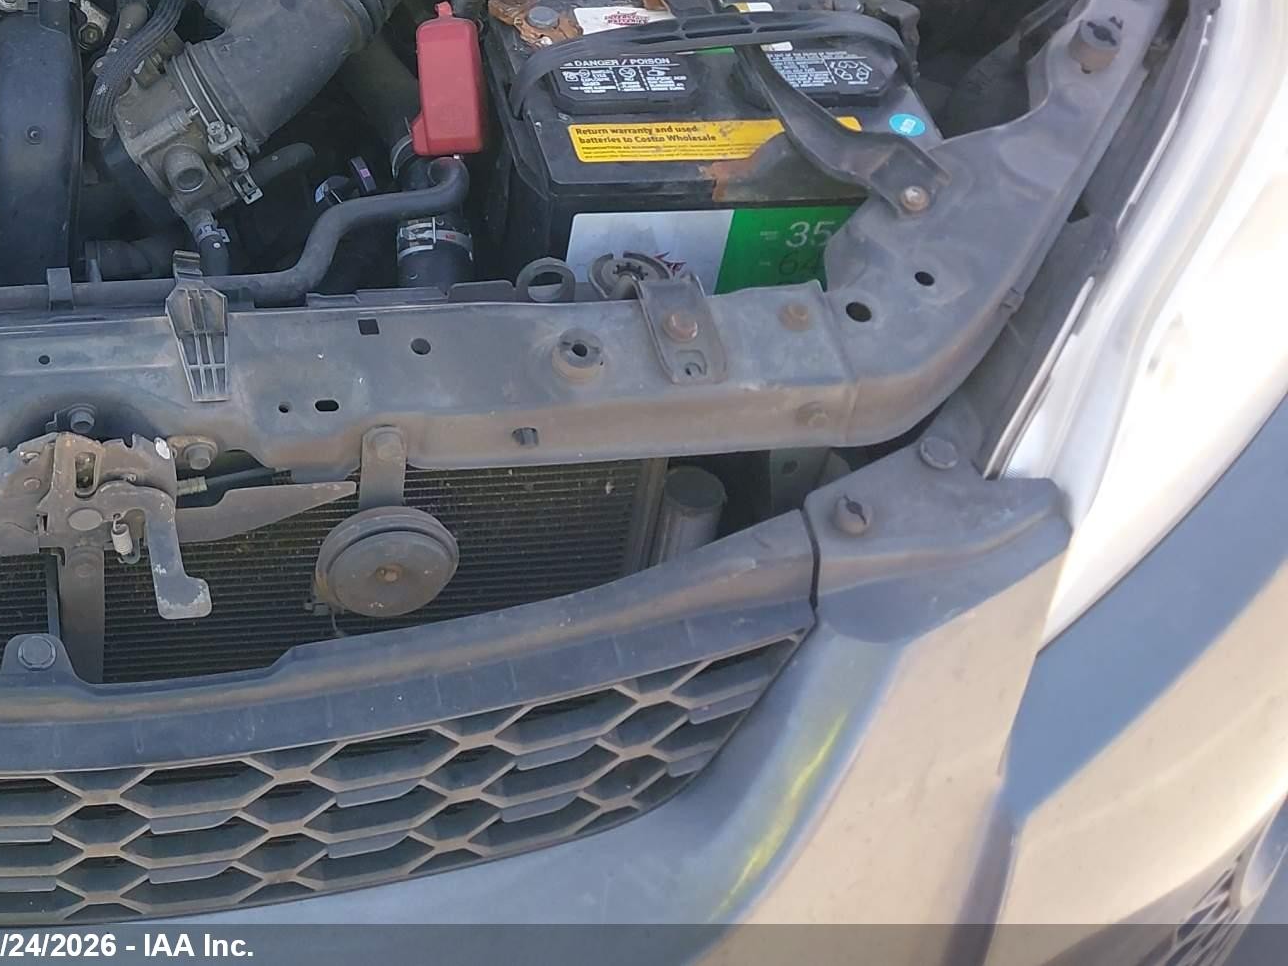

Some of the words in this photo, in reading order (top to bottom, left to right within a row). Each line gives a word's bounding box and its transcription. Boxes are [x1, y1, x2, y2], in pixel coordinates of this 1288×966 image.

[575, 58, 618, 67] DANGER
[629, 57, 671, 66] POISON
[575, 127, 609, 136] Return
[610, 127, 653, 137] warranty
[655, 125, 673, 134] and
[675, 125, 697, 134] used
[578, 135, 621, 144] batteries
[623, 135, 632, 143] to
[634, 134, 665, 143] Costco
[667, 133, 716, 143] Wholesale
